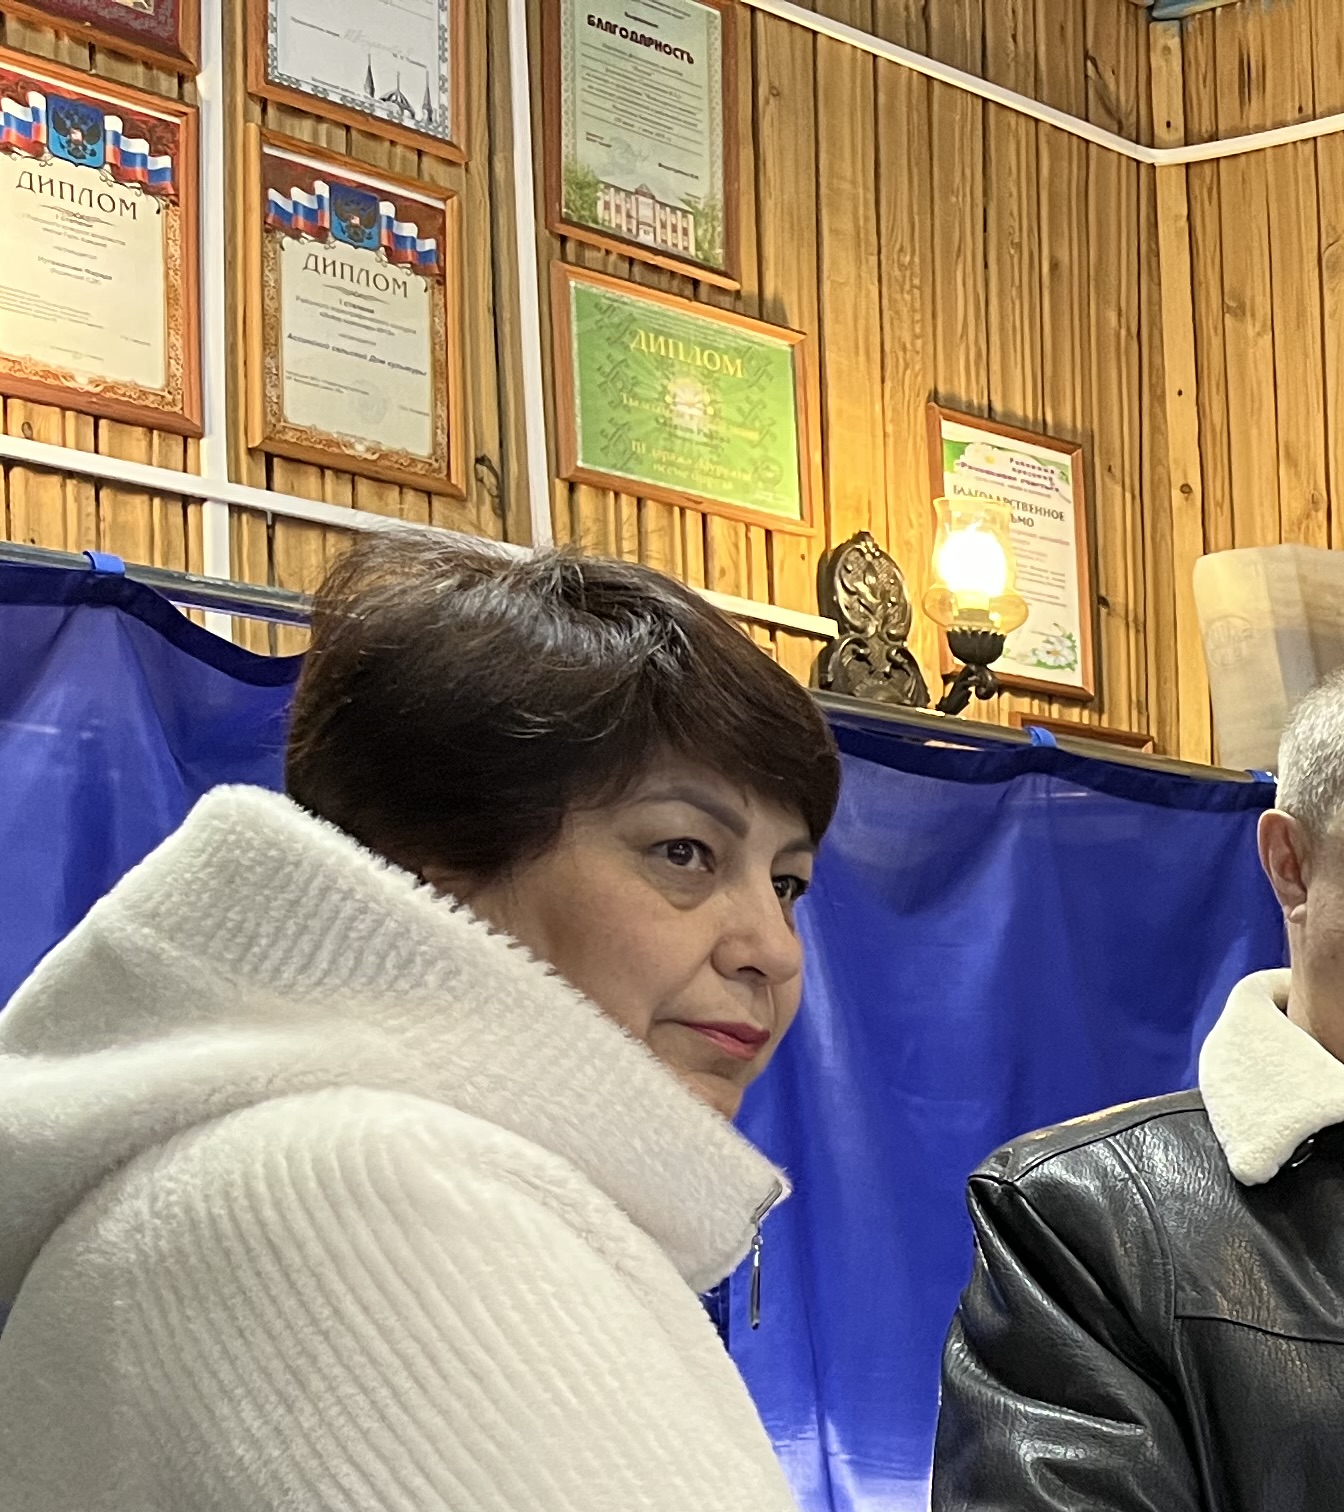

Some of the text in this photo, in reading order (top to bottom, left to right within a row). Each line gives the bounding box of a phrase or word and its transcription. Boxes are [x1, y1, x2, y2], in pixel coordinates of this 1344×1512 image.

[586, 14, 695, 65] БЛАГОДАРНОСТЬ
[15, 170, 137, 220] ДИПЛОМ
[302, 253, 408, 298] ДИПЛОМ
[630, 328, 744, 378] ДИПЛОМ
